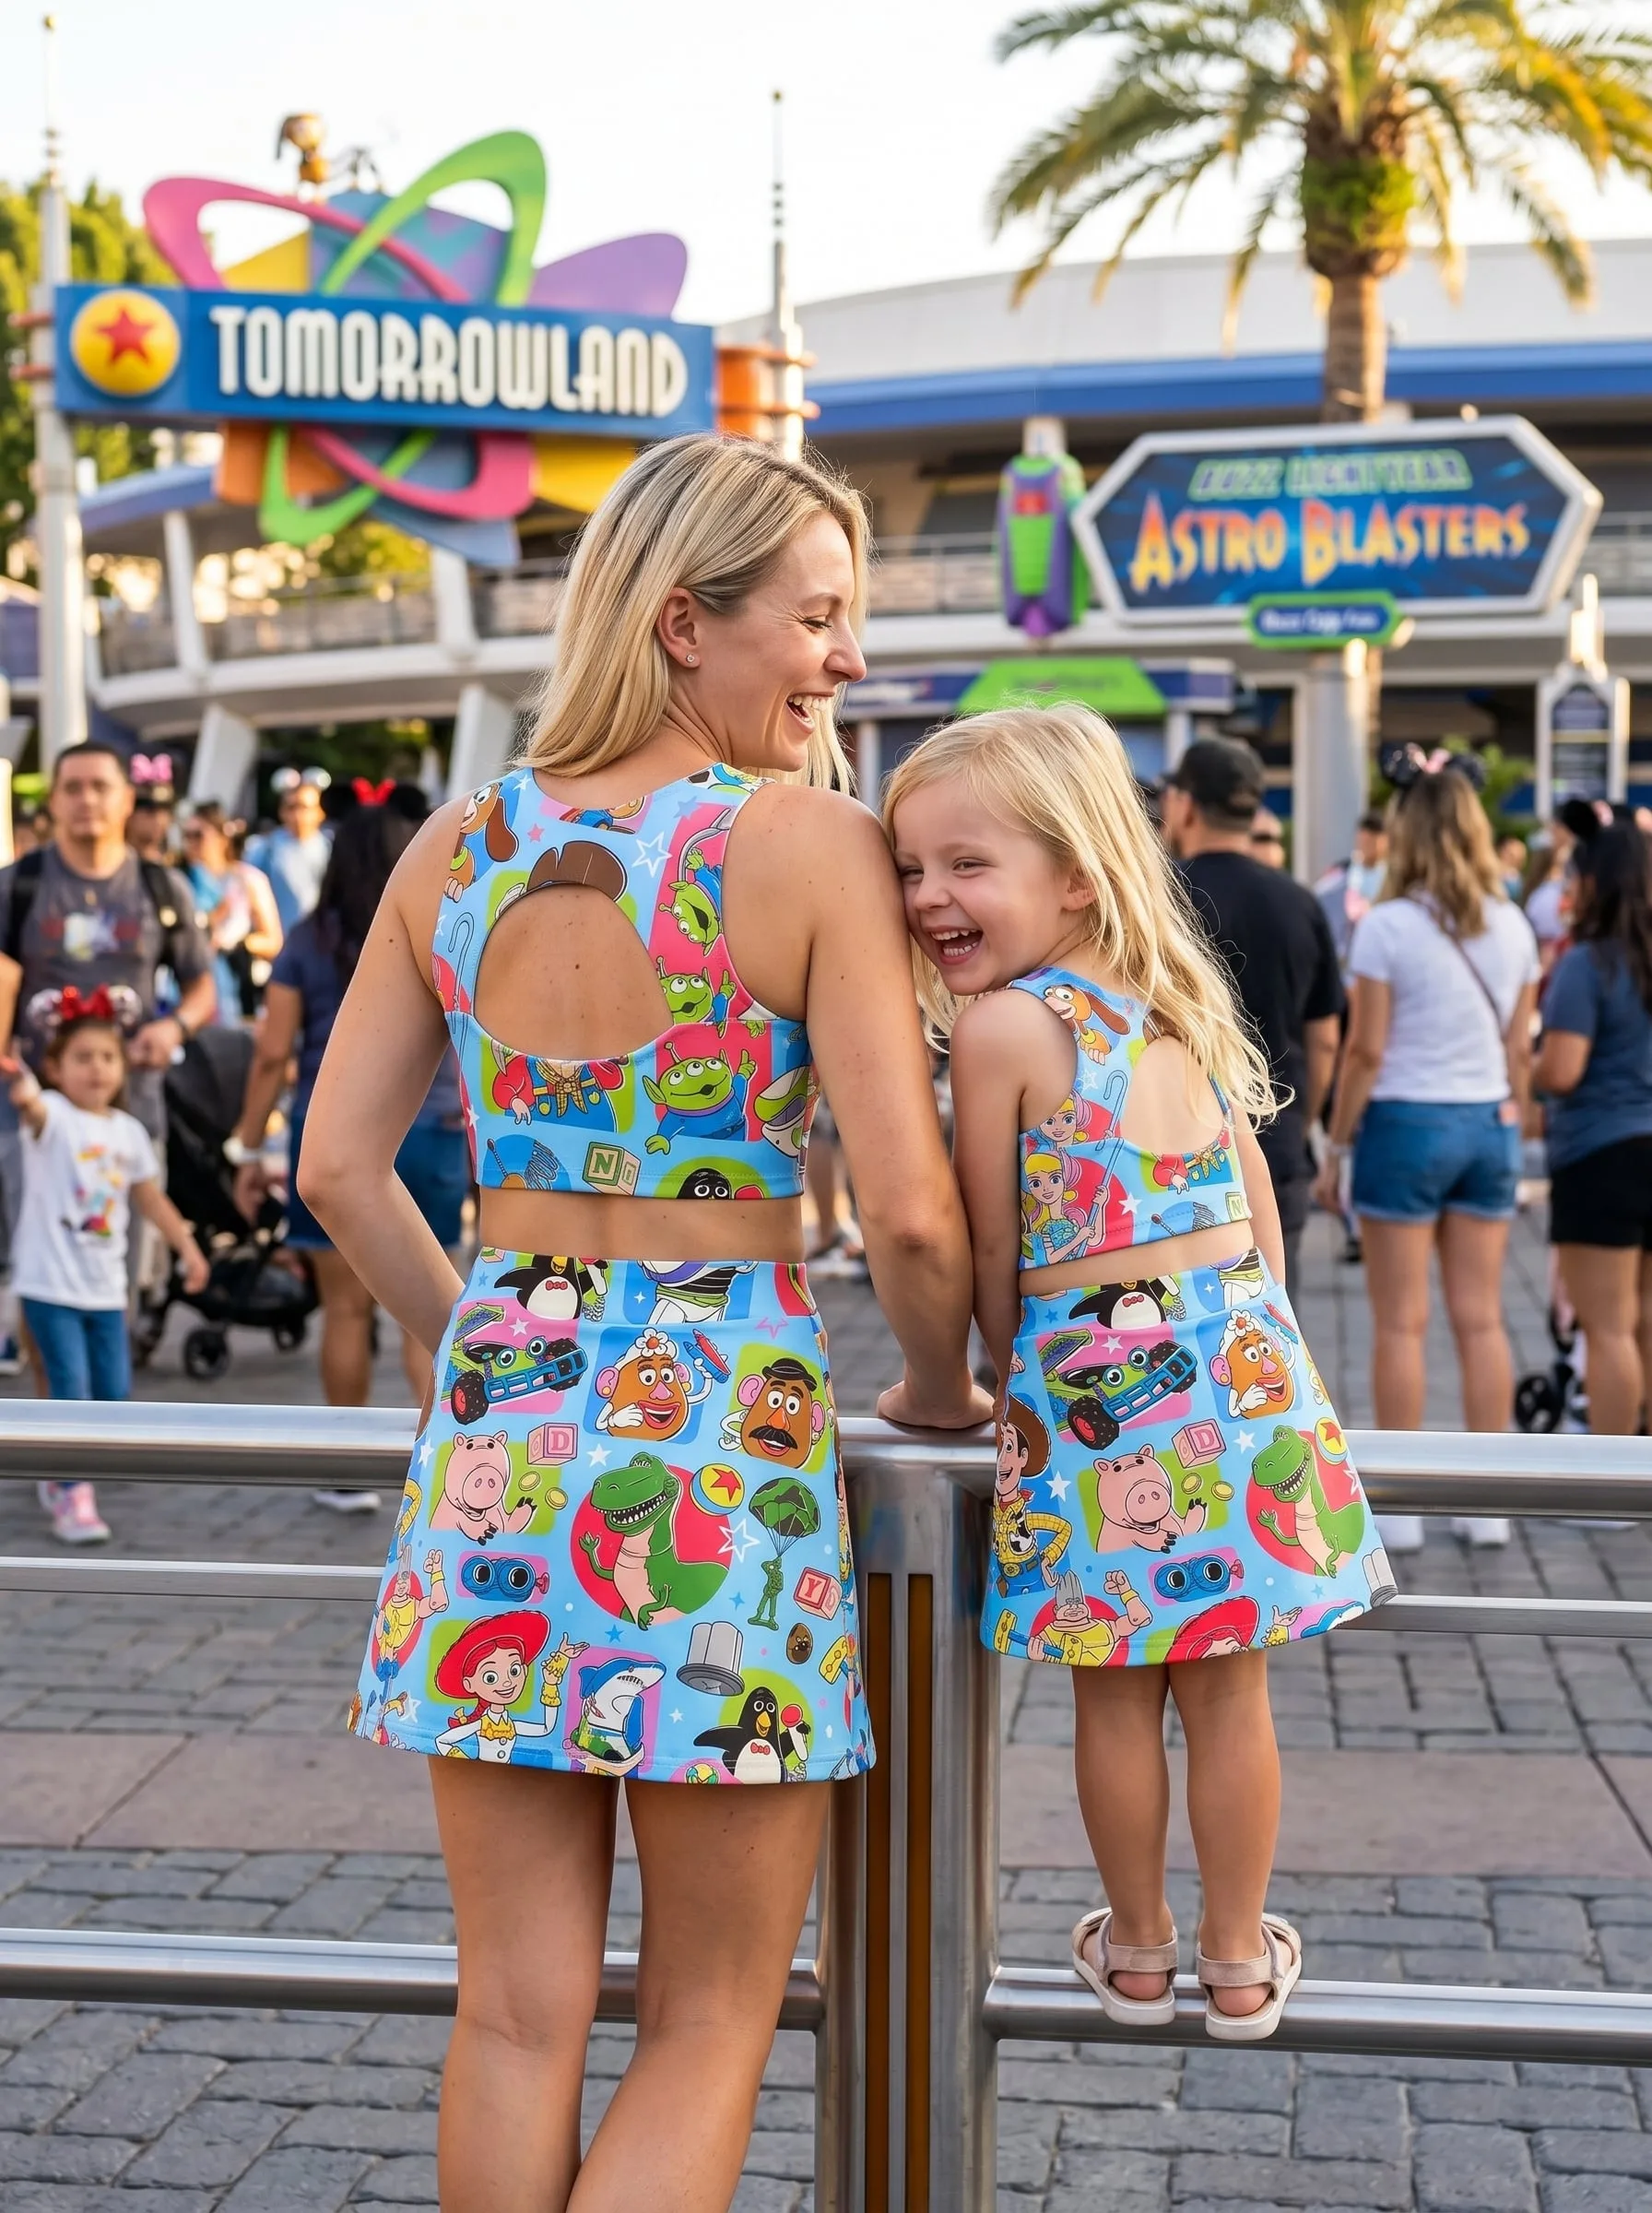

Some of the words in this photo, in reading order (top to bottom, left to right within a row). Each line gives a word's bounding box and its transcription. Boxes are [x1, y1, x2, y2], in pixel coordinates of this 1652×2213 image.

[210, 306, 688, 418] TOMORROWLAND
[1129, 491, 1286, 593] ASTRO
[1302, 497, 1530, 587] BLASTERS
[593, 1153, 615, 1175] N
[551, 1430, 570, 1451] D
[1194, 1428, 1215, 1450] D
[804, 1577, 822, 1598] Y
